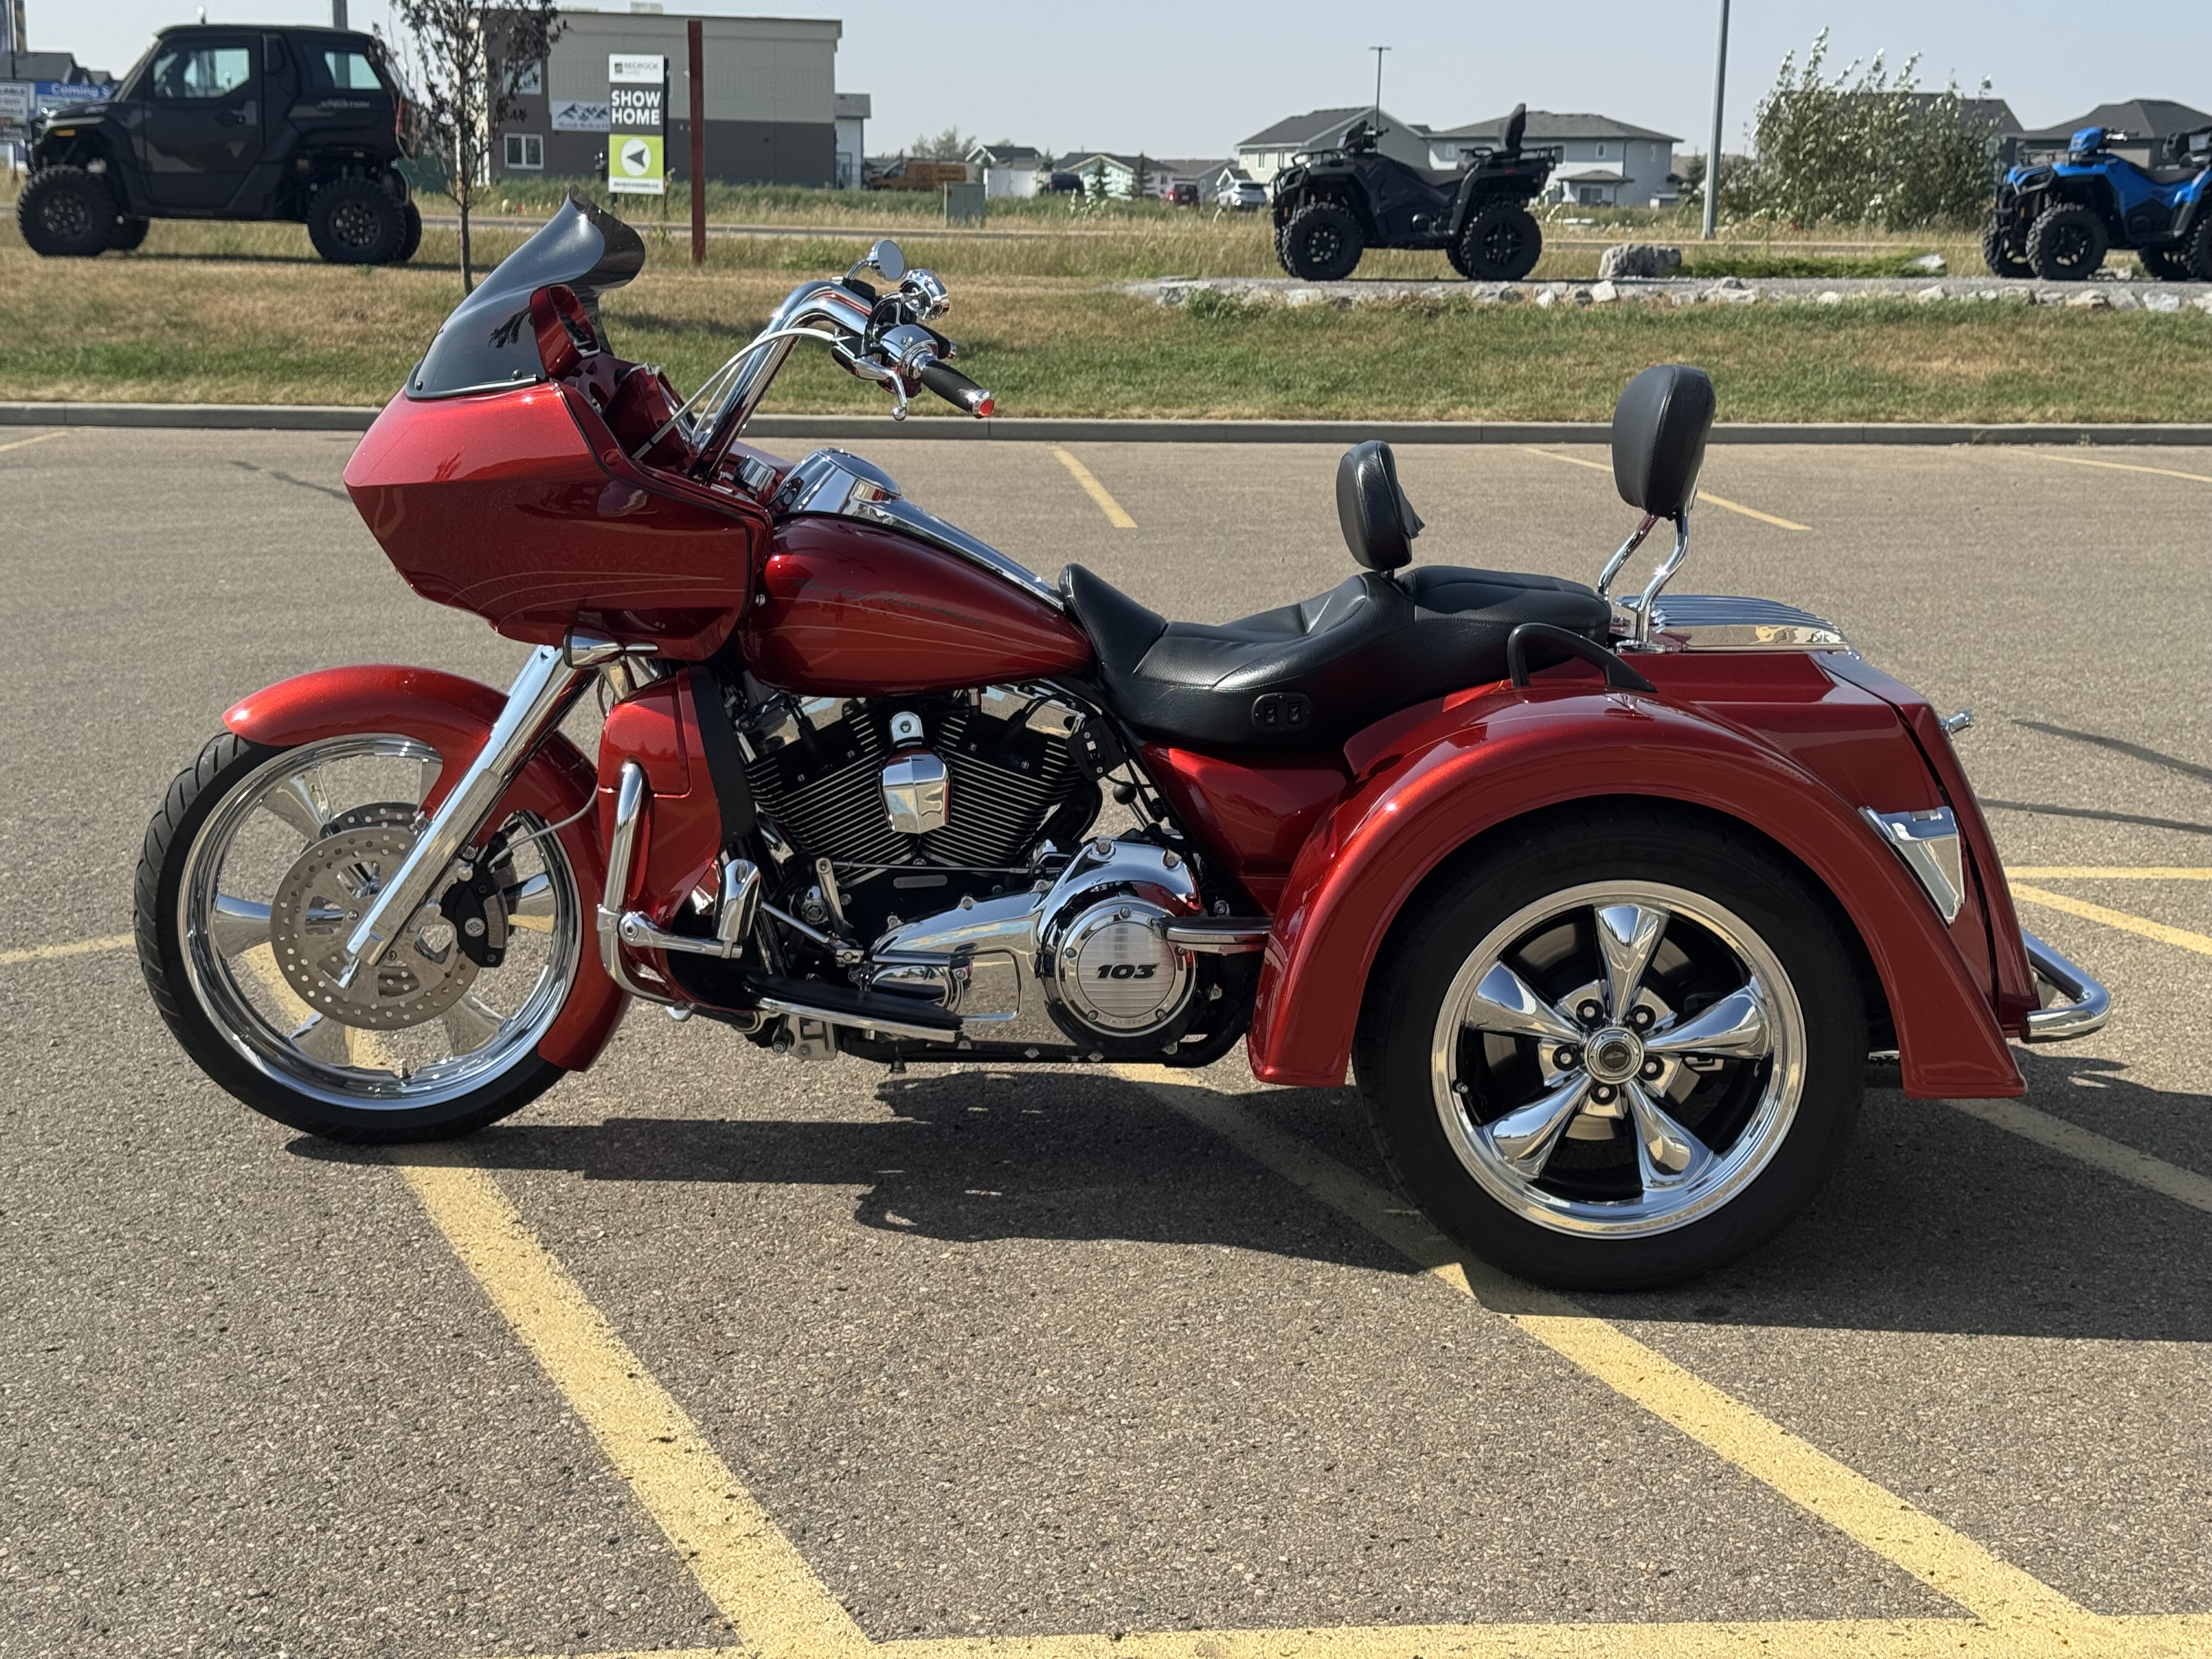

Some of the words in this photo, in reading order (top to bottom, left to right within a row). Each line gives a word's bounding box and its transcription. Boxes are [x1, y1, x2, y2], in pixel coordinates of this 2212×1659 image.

[50, 83, 99, 98] Coming
[611, 89, 661, 108] SHOW
[611, 108, 661, 125] HOME
[1097, 964, 1158, 979] 103
